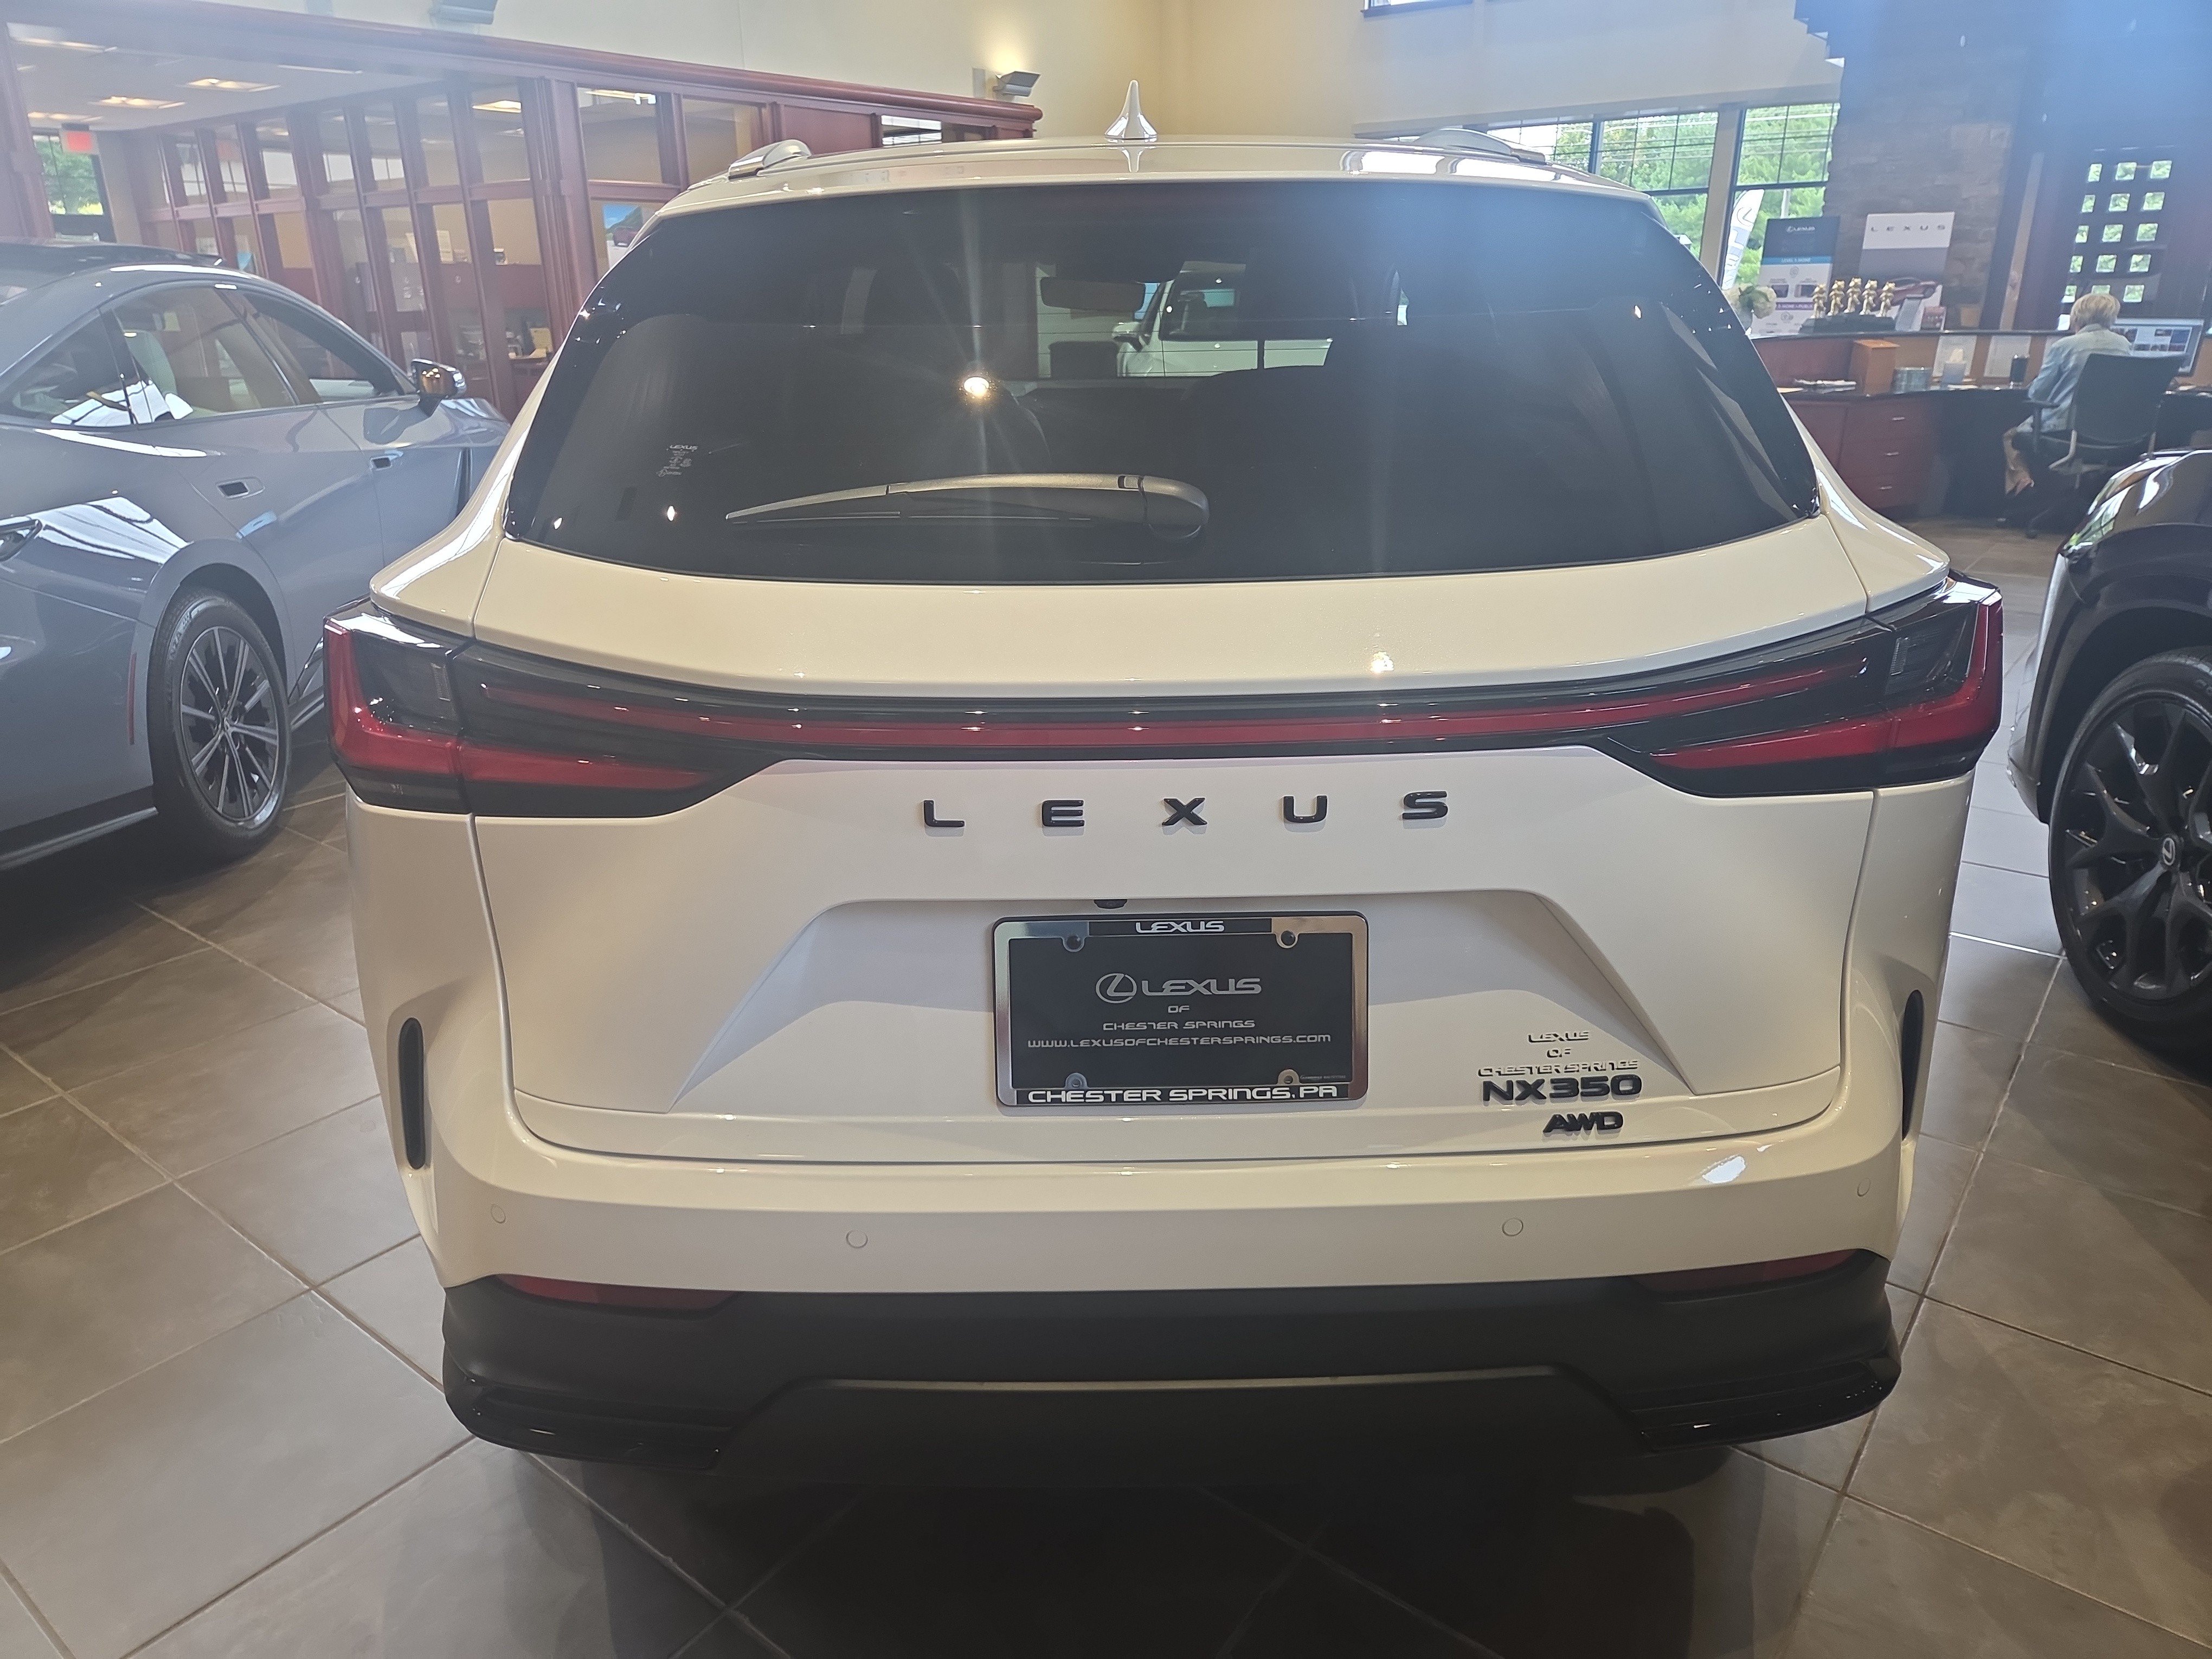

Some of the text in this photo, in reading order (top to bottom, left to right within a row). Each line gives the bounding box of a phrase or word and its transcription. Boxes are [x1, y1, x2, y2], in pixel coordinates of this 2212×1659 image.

[1871, 224, 1946, 232] LEXUS
[924, 791, 1448, 827] LEXUS
[1136, 921, 1225, 933] LEXUS
[1141, 978, 1262, 996] LEXUS
[1168, 1005, 1190, 1013] OF
[1103, 1020, 1255, 1031] CHESTER SPRINGS
[1028, 1034, 1331, 1047] WWW.LEXUSOFCHESTERSPRINGS.COM
[1528, 1031, 1589, 1043] LEXUS
[1547, 1048, 1571, 1058] OF
[1478, 1065, 1560, 1077] CHESTER
[1028, 1089, 1161, 1103] CHESTER
[1542, 1111, 1623, 1133] AWD
